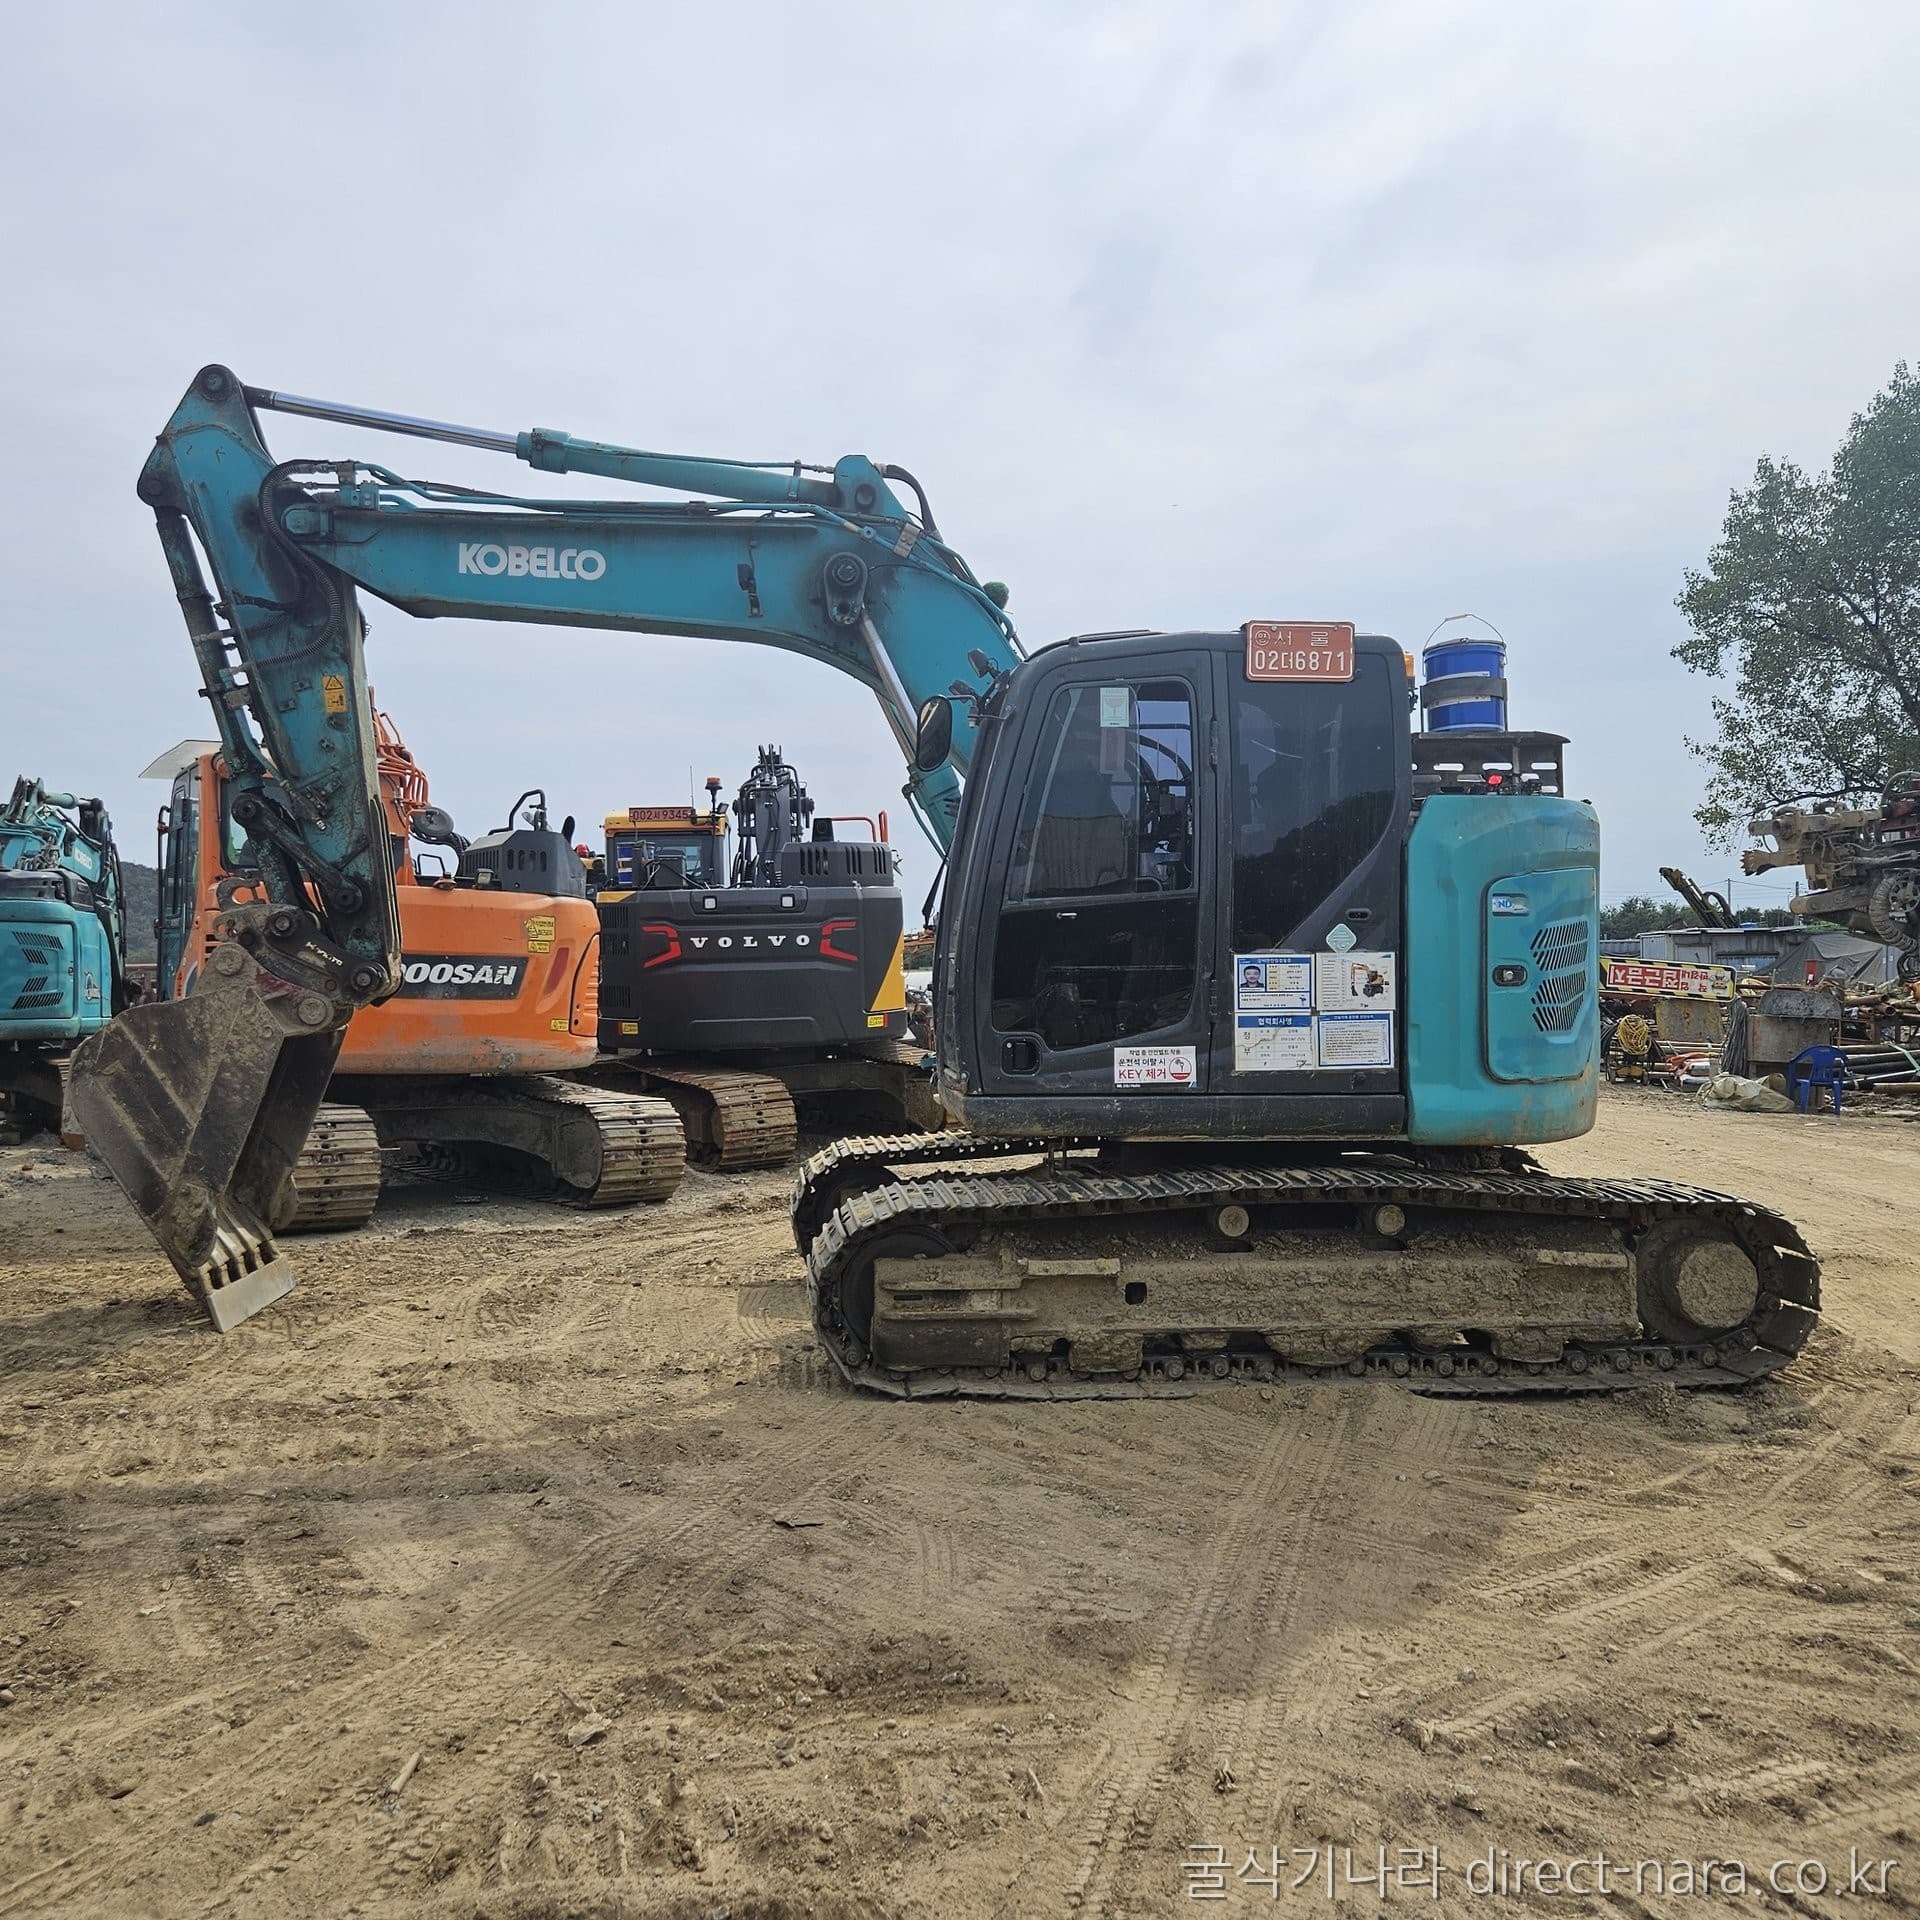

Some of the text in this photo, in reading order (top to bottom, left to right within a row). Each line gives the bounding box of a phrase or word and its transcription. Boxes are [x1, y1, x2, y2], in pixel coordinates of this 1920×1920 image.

[458, 542, 606, 581] KOBELCO
[1254, 650, 1346, 672] 02더6871
[690, 934, 810, 949] VOLVO
[400, 962, 517, 985] OOSAN
[1610, 965, 1679, 989] 접근금지
[1119, 1067, 1166, 1079] KEY 제거
